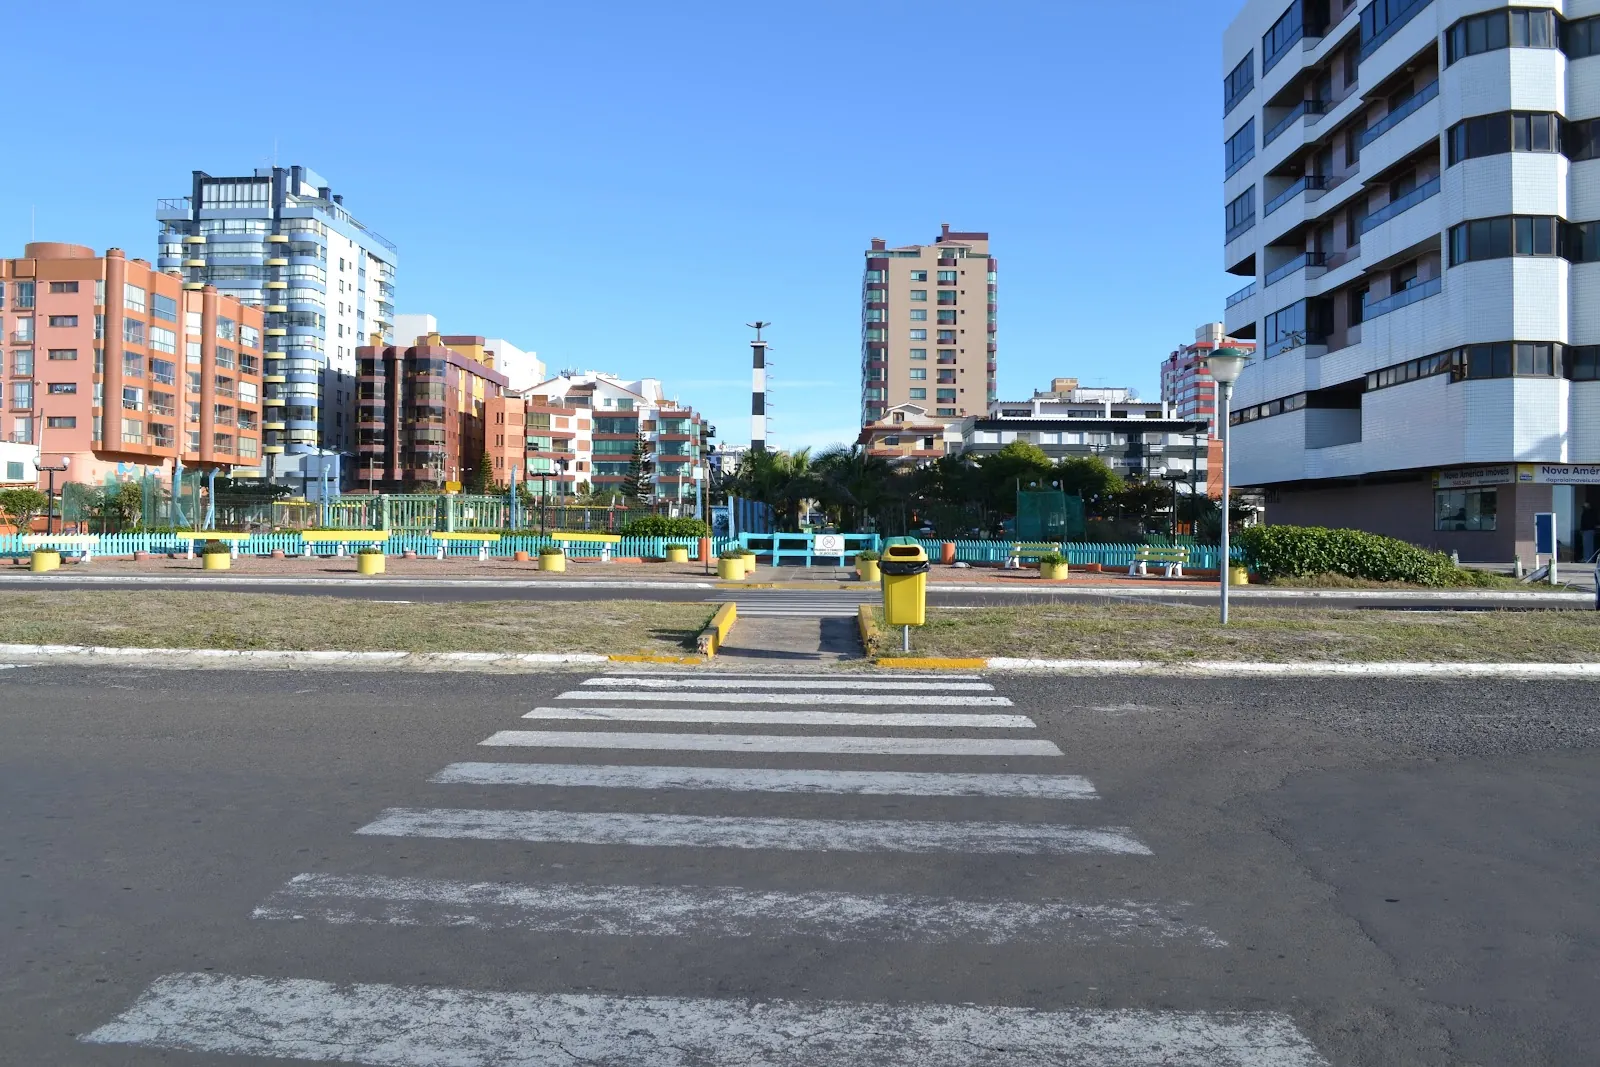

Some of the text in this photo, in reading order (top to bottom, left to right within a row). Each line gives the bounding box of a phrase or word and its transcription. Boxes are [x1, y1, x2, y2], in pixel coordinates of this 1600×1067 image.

[1444, 466, 1510, 480] Nova América Imóveis
[1542, 466, 1600, 475] Nova Amér
